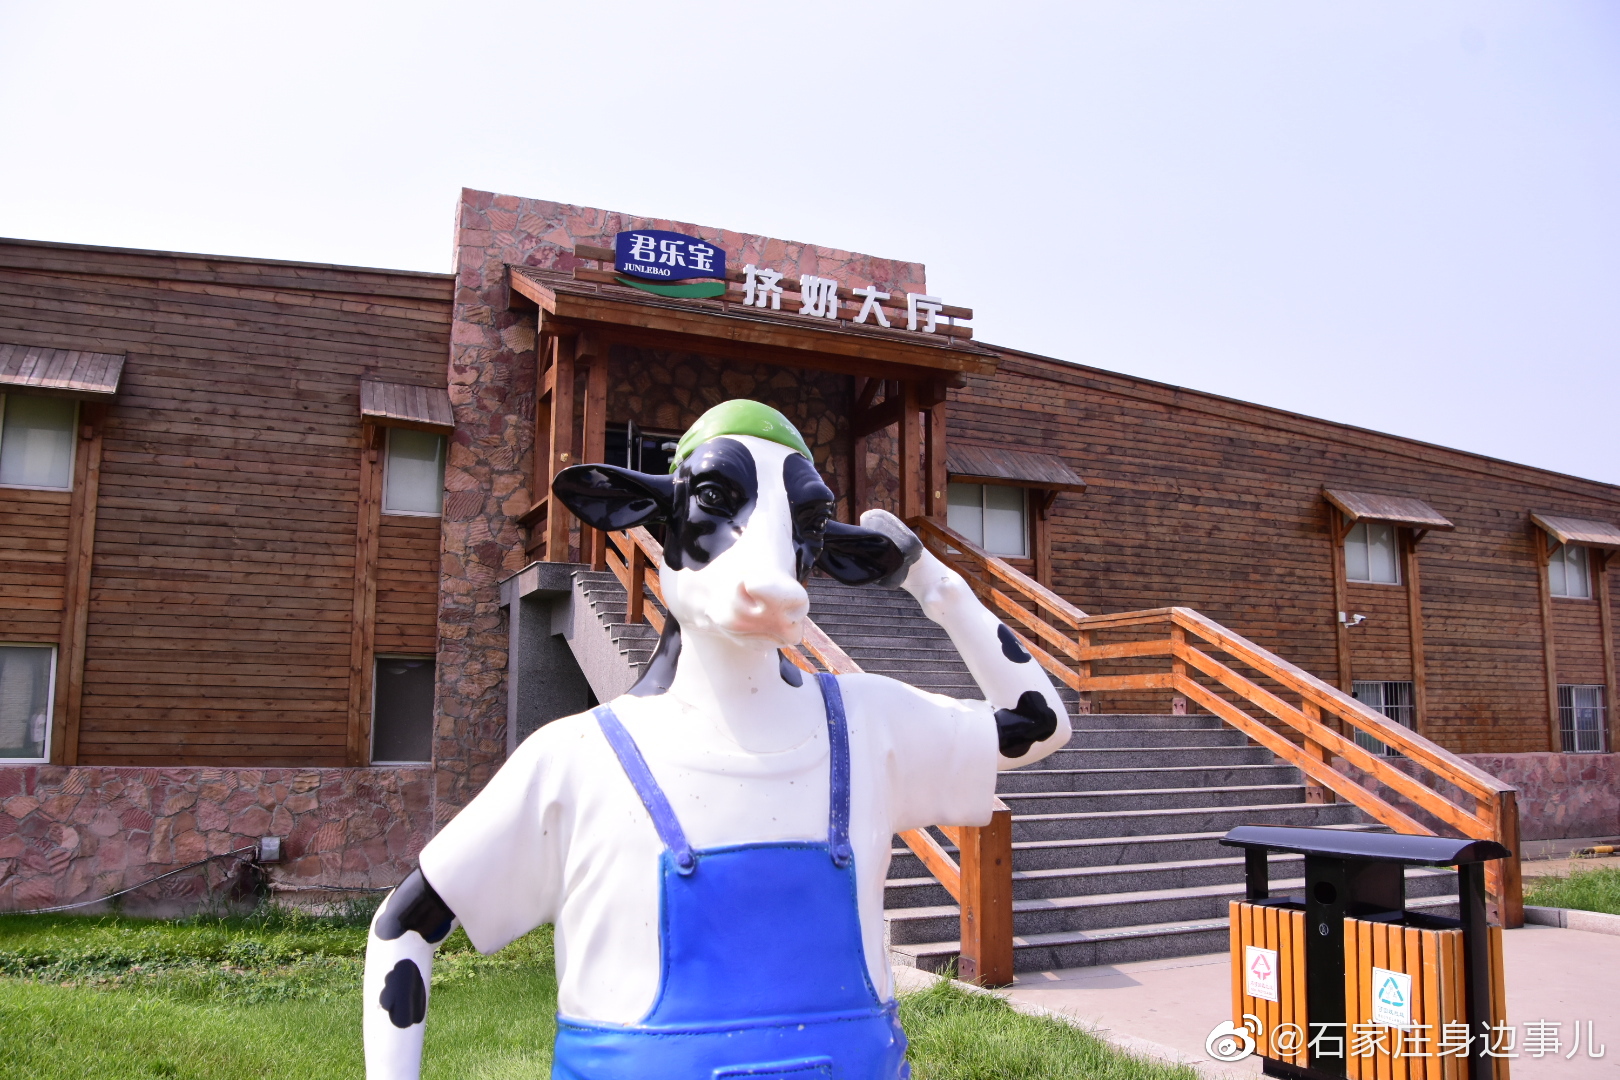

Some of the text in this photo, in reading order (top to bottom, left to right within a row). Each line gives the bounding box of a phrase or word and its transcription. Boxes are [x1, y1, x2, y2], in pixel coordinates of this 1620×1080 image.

[623, 262, 671, 277] JUNLEBAO
[629, 234, 714, 272] 君乐宝
[743, 263, 942, 333] 挤奶大厅
